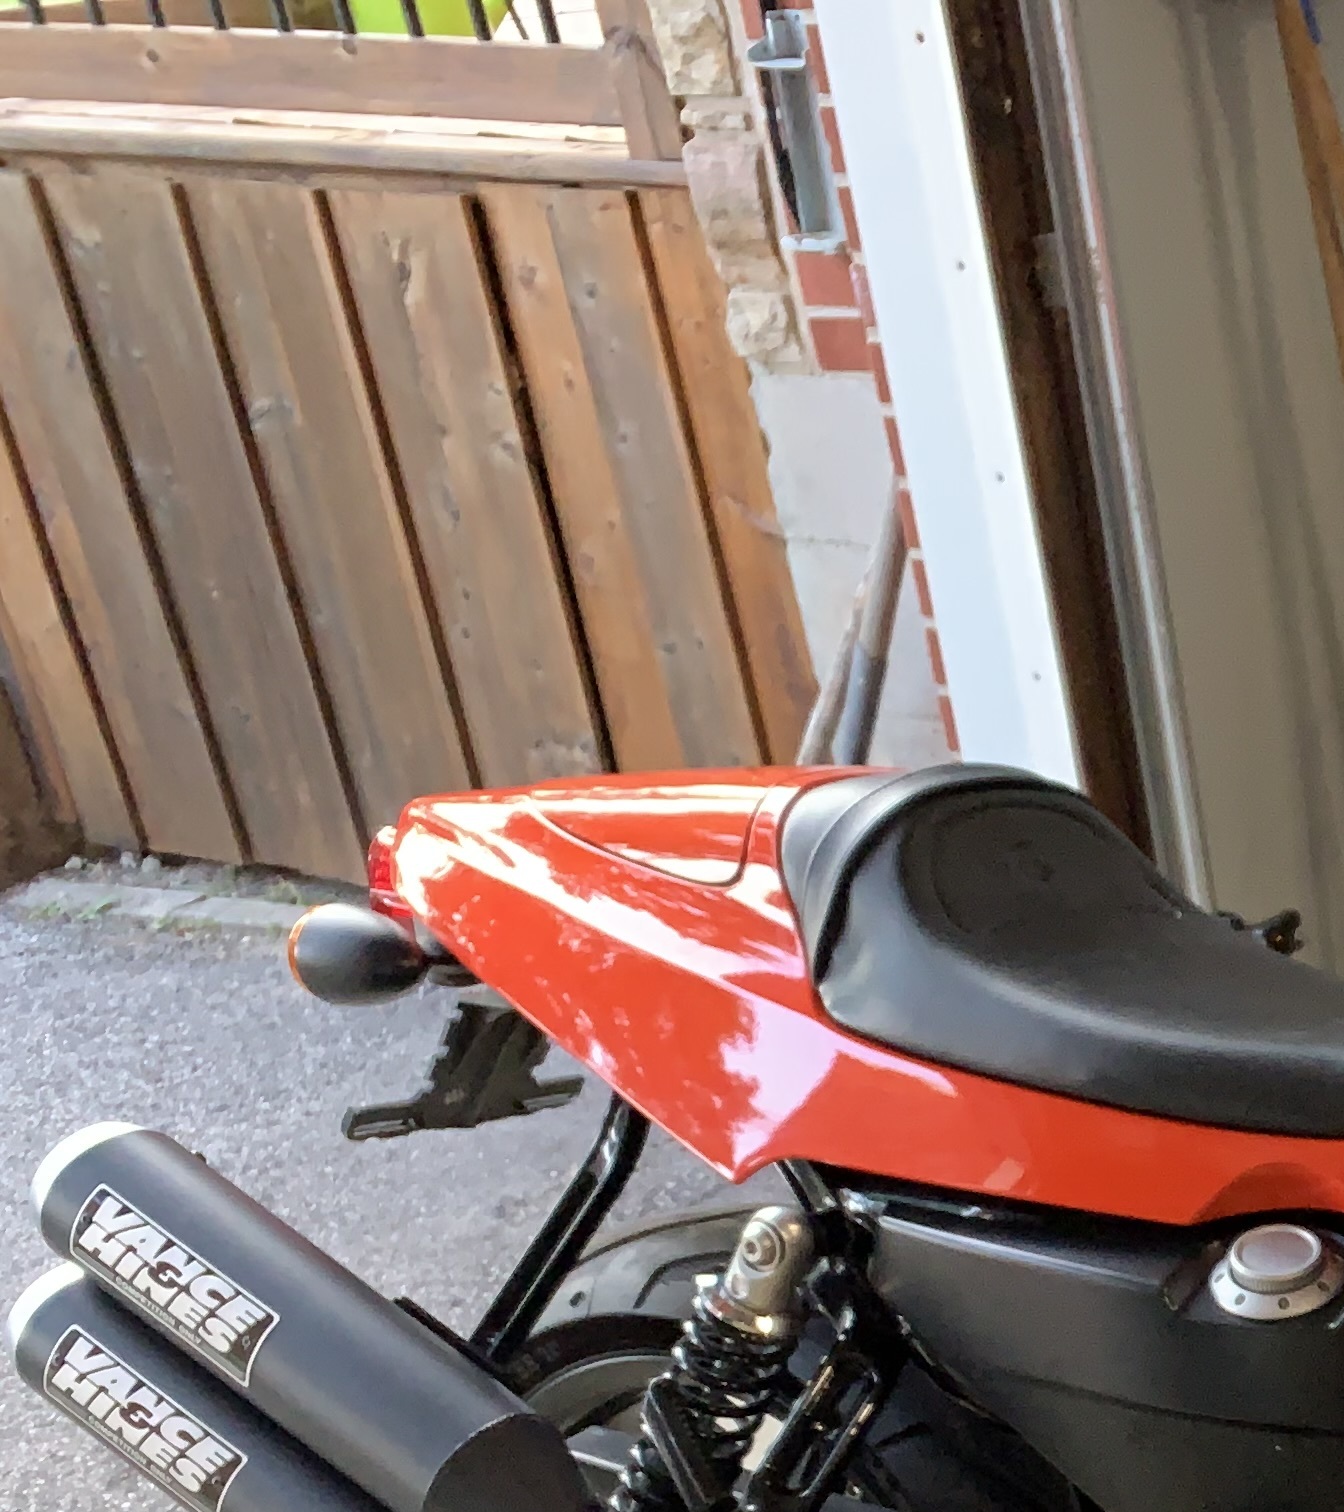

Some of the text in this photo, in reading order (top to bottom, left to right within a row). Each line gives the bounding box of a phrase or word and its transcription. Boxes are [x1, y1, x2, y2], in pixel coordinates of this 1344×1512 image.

[78, 1221, 238, 1353] HINES
[91, 1195, 267, 1334] VANCE
[51, 1363, 208, 1493] HINES
[64, 1336, 235, 1474] VANCE
